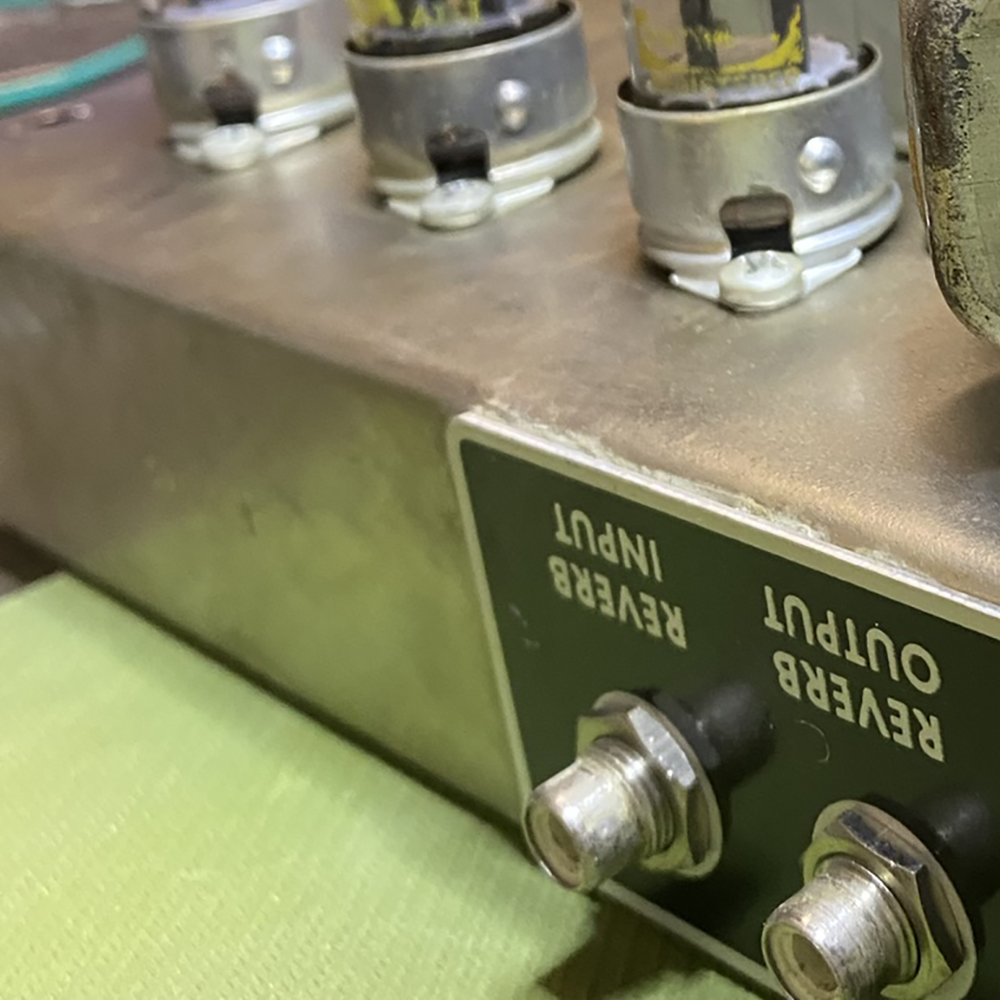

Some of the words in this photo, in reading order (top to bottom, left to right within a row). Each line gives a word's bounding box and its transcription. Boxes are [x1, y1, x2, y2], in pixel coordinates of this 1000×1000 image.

[554, 502, 662, 582] INPUT
[548, 555, 687, 649] REVERB
[763, 585, 941, 694] OUTPUT
[773, 650, 945, 762] REVERB
